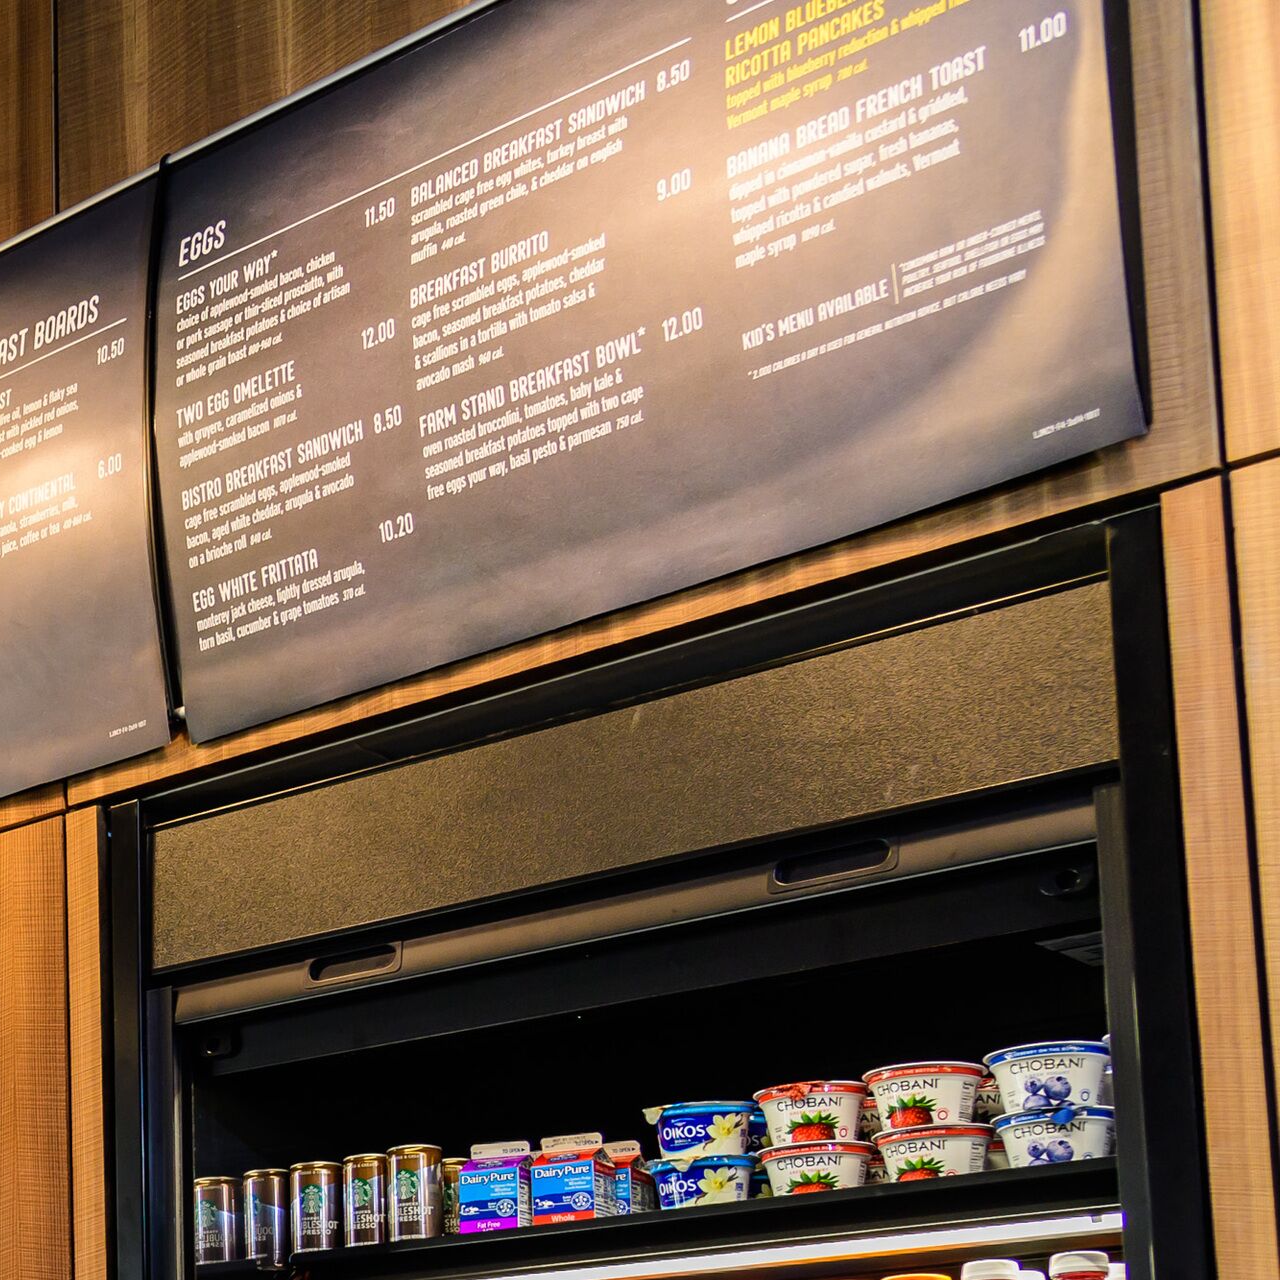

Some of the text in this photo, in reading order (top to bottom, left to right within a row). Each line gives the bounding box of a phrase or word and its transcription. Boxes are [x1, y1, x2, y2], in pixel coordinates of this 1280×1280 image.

[725, 16, 780, 61] LEMON
[725, 0, 885, 89] RICOTTA PANCAKES
[1018, 12, 1067, 53] 11.00
[411, 59, 690, 207] BALANCED BREAKFAST SANDWICH 8.50
[727, 46, 986, 179] BANANA BREAD FRENCH TOAST
[656, 168, 690, 201] 9.00
[364, 197, 395, 229] 11.50
[178, 220, 227, 267] EGGS
[177, 311, 198, 333] choice
[201, 307, 209, 319] of
[210, 277, 278, 319] applewood-smoked
[307, 250, 335, 274] chicken
[410, 230, 548, 309] BREAKFAST BURRITO
[176, 284, 205, 315] EGGS
[210, 270, 238, 299] YOUR
[778, 308, 814, 337] MENU
[818, 279, 888, 322] AVAILABLE
[33, 295, 99, 350] BOARDS
[361, 318, 395, 350] 12.00
[96, 337, 125, 366] 10.50
[419, 403, 456, 438] FARM
[462, 385, 505, 421] STAND
[510, 350, 590, 403] BREAKFAST
[662, 307, 703, 342] 12.00
[176, 361, 295, 428] TWO EGG OMELETTE
[182, 405, 402, 511] BISTRO BREAKFAST SANDWICH 8.50
[379, 512, 413, 543] 10.20
[192, 549, 318, 612] EGG WHITE FRITTATA
[877, 1078, 940, 1097] CHOBANI
[1010, 1057, 1087, 1075] CHOBANI
[777, 1096, 843, 1112] CHOBANI
[663, 1124, 705, 1141] OIKOS
[1014, 1121, 1088, 1139] CHOBANI
[659, 1179, 697, 1197] OIKOS
[551, 1213, 575, 1222] Whole
